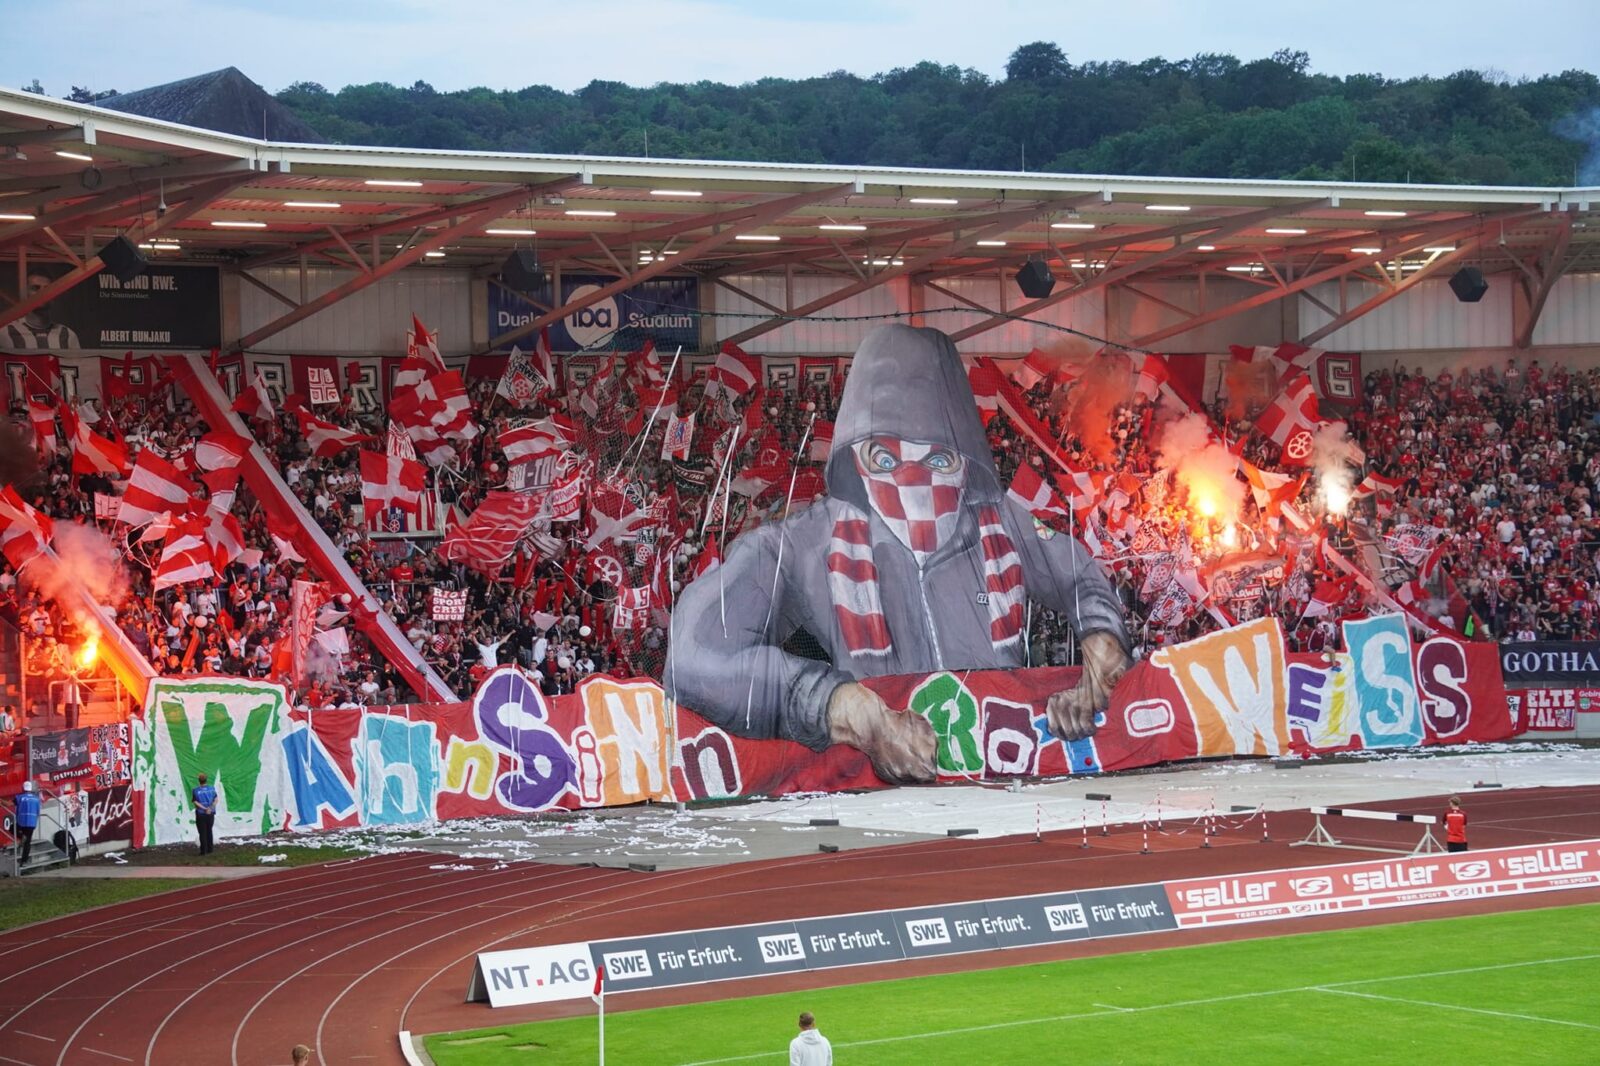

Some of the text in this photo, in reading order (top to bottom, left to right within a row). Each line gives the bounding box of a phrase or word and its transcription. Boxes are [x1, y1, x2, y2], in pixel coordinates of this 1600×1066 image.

[99, 274, 120, 288] WIR
[152, 275, 178, 290] RWE.
[498, 311, 552, 328] Dual
[628, 312, 693, 328] Studium
[100, 330, 171, 343] ALBERT BUNJAKU
[433, 597, 466, 606] SPORT
[432, 613, 465, 621] ERFUR
[1503, 652, 1599, 673] GOTHA
[1527, 689, 1575, 708] ELTE
[1579, 690, 1600, 699] Gebir
[1528, 708, 1556, 728] TAL
[89, 785, 133, 835] Block
[1050, 899, 1164, 927] SWE Für Erfurt.
[912, 913, 1031, 942] SWE Für Erfurt.
[764, 928, 890, 958] SWE Für Erfurt.
[609, 945, 742, 975] SWE Für Erfurt.
[490, 959, 590, 991] NT.AG
